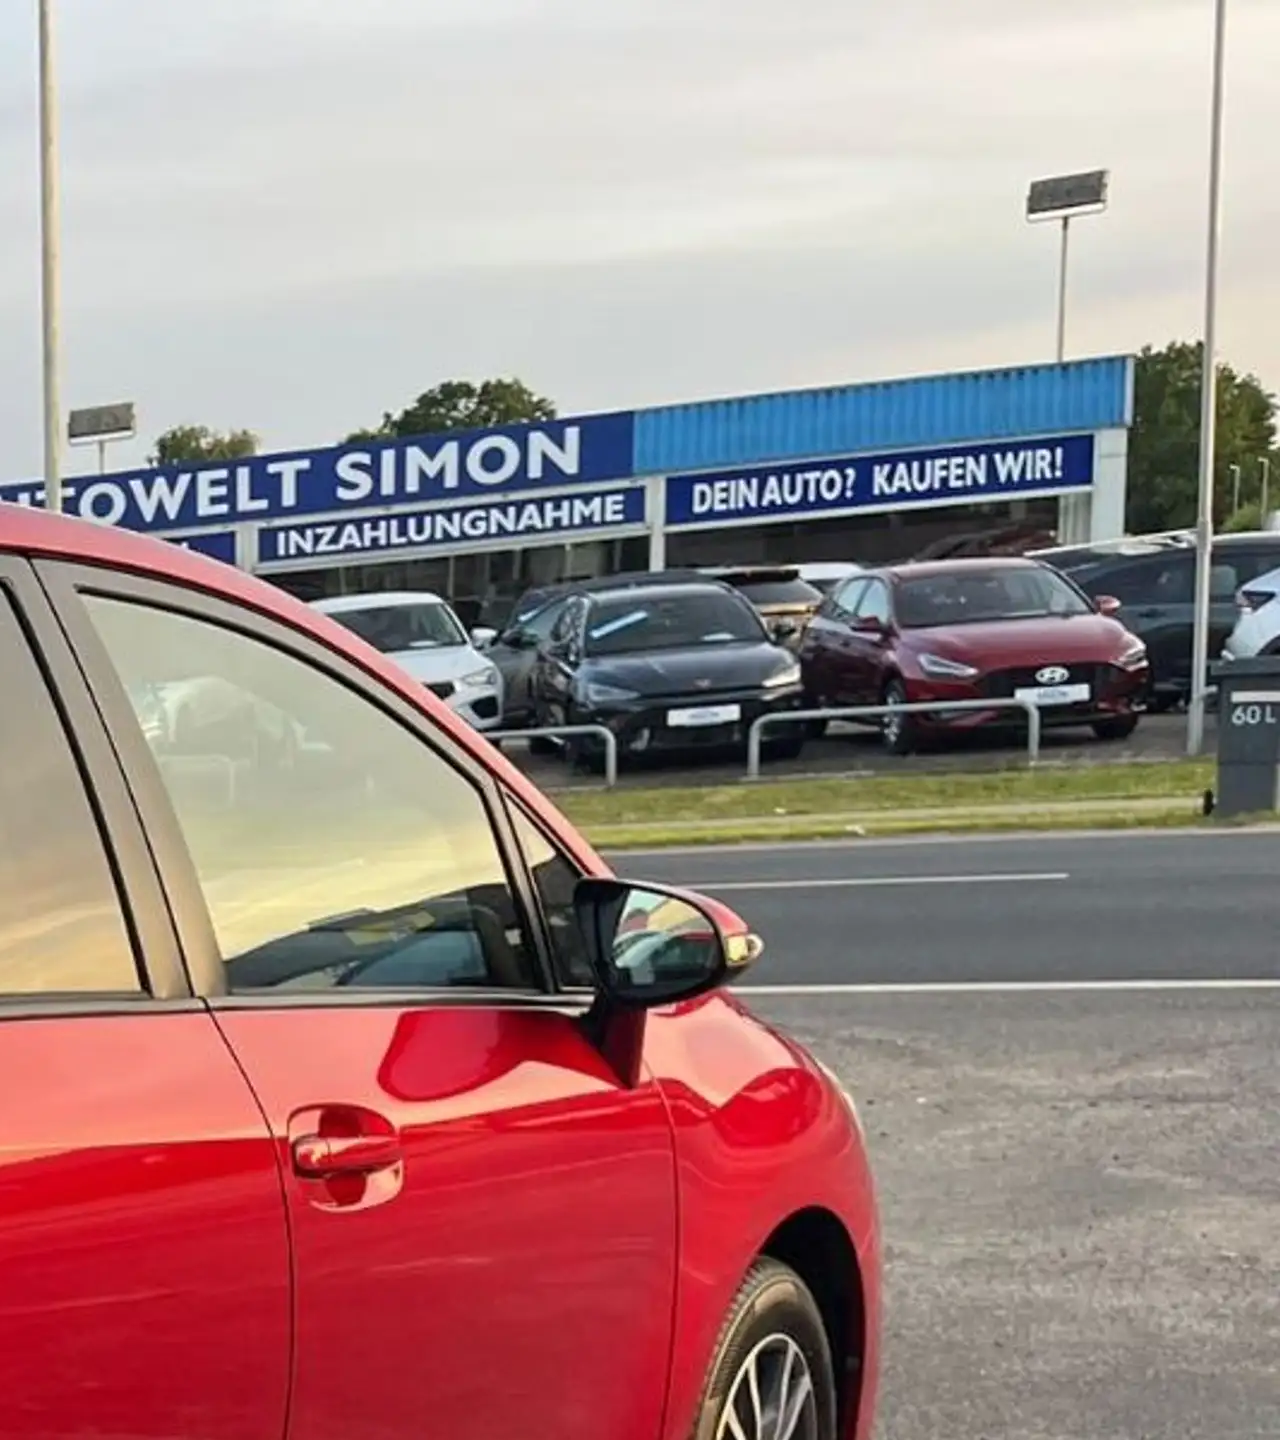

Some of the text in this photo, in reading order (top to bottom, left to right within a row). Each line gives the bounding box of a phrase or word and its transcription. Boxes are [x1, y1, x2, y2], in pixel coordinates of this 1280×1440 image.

[336, 427, 581, 501] SIMON
[692, 446, 1064, 515] DEIN AUTO? KAUFEN WIR!
[277, 494, 625, 557] INZAHLUNGNAHME
